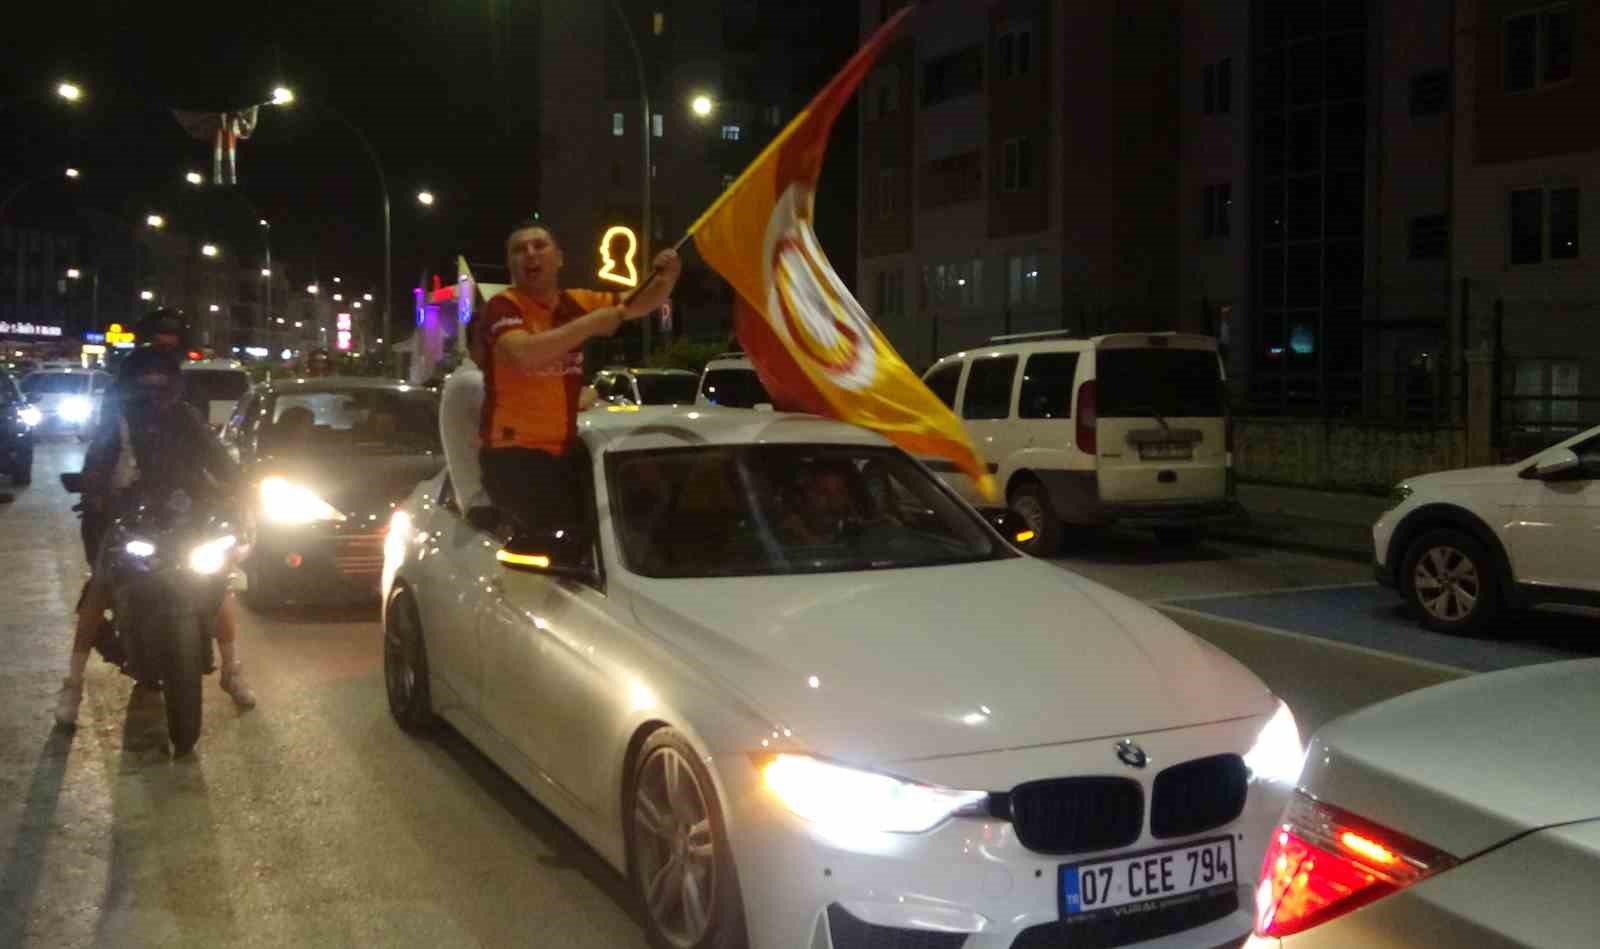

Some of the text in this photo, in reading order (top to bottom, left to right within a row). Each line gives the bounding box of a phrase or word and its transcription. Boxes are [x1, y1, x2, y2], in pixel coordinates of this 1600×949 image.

[1082, 846, 1229, 905] 07 CEE 794
